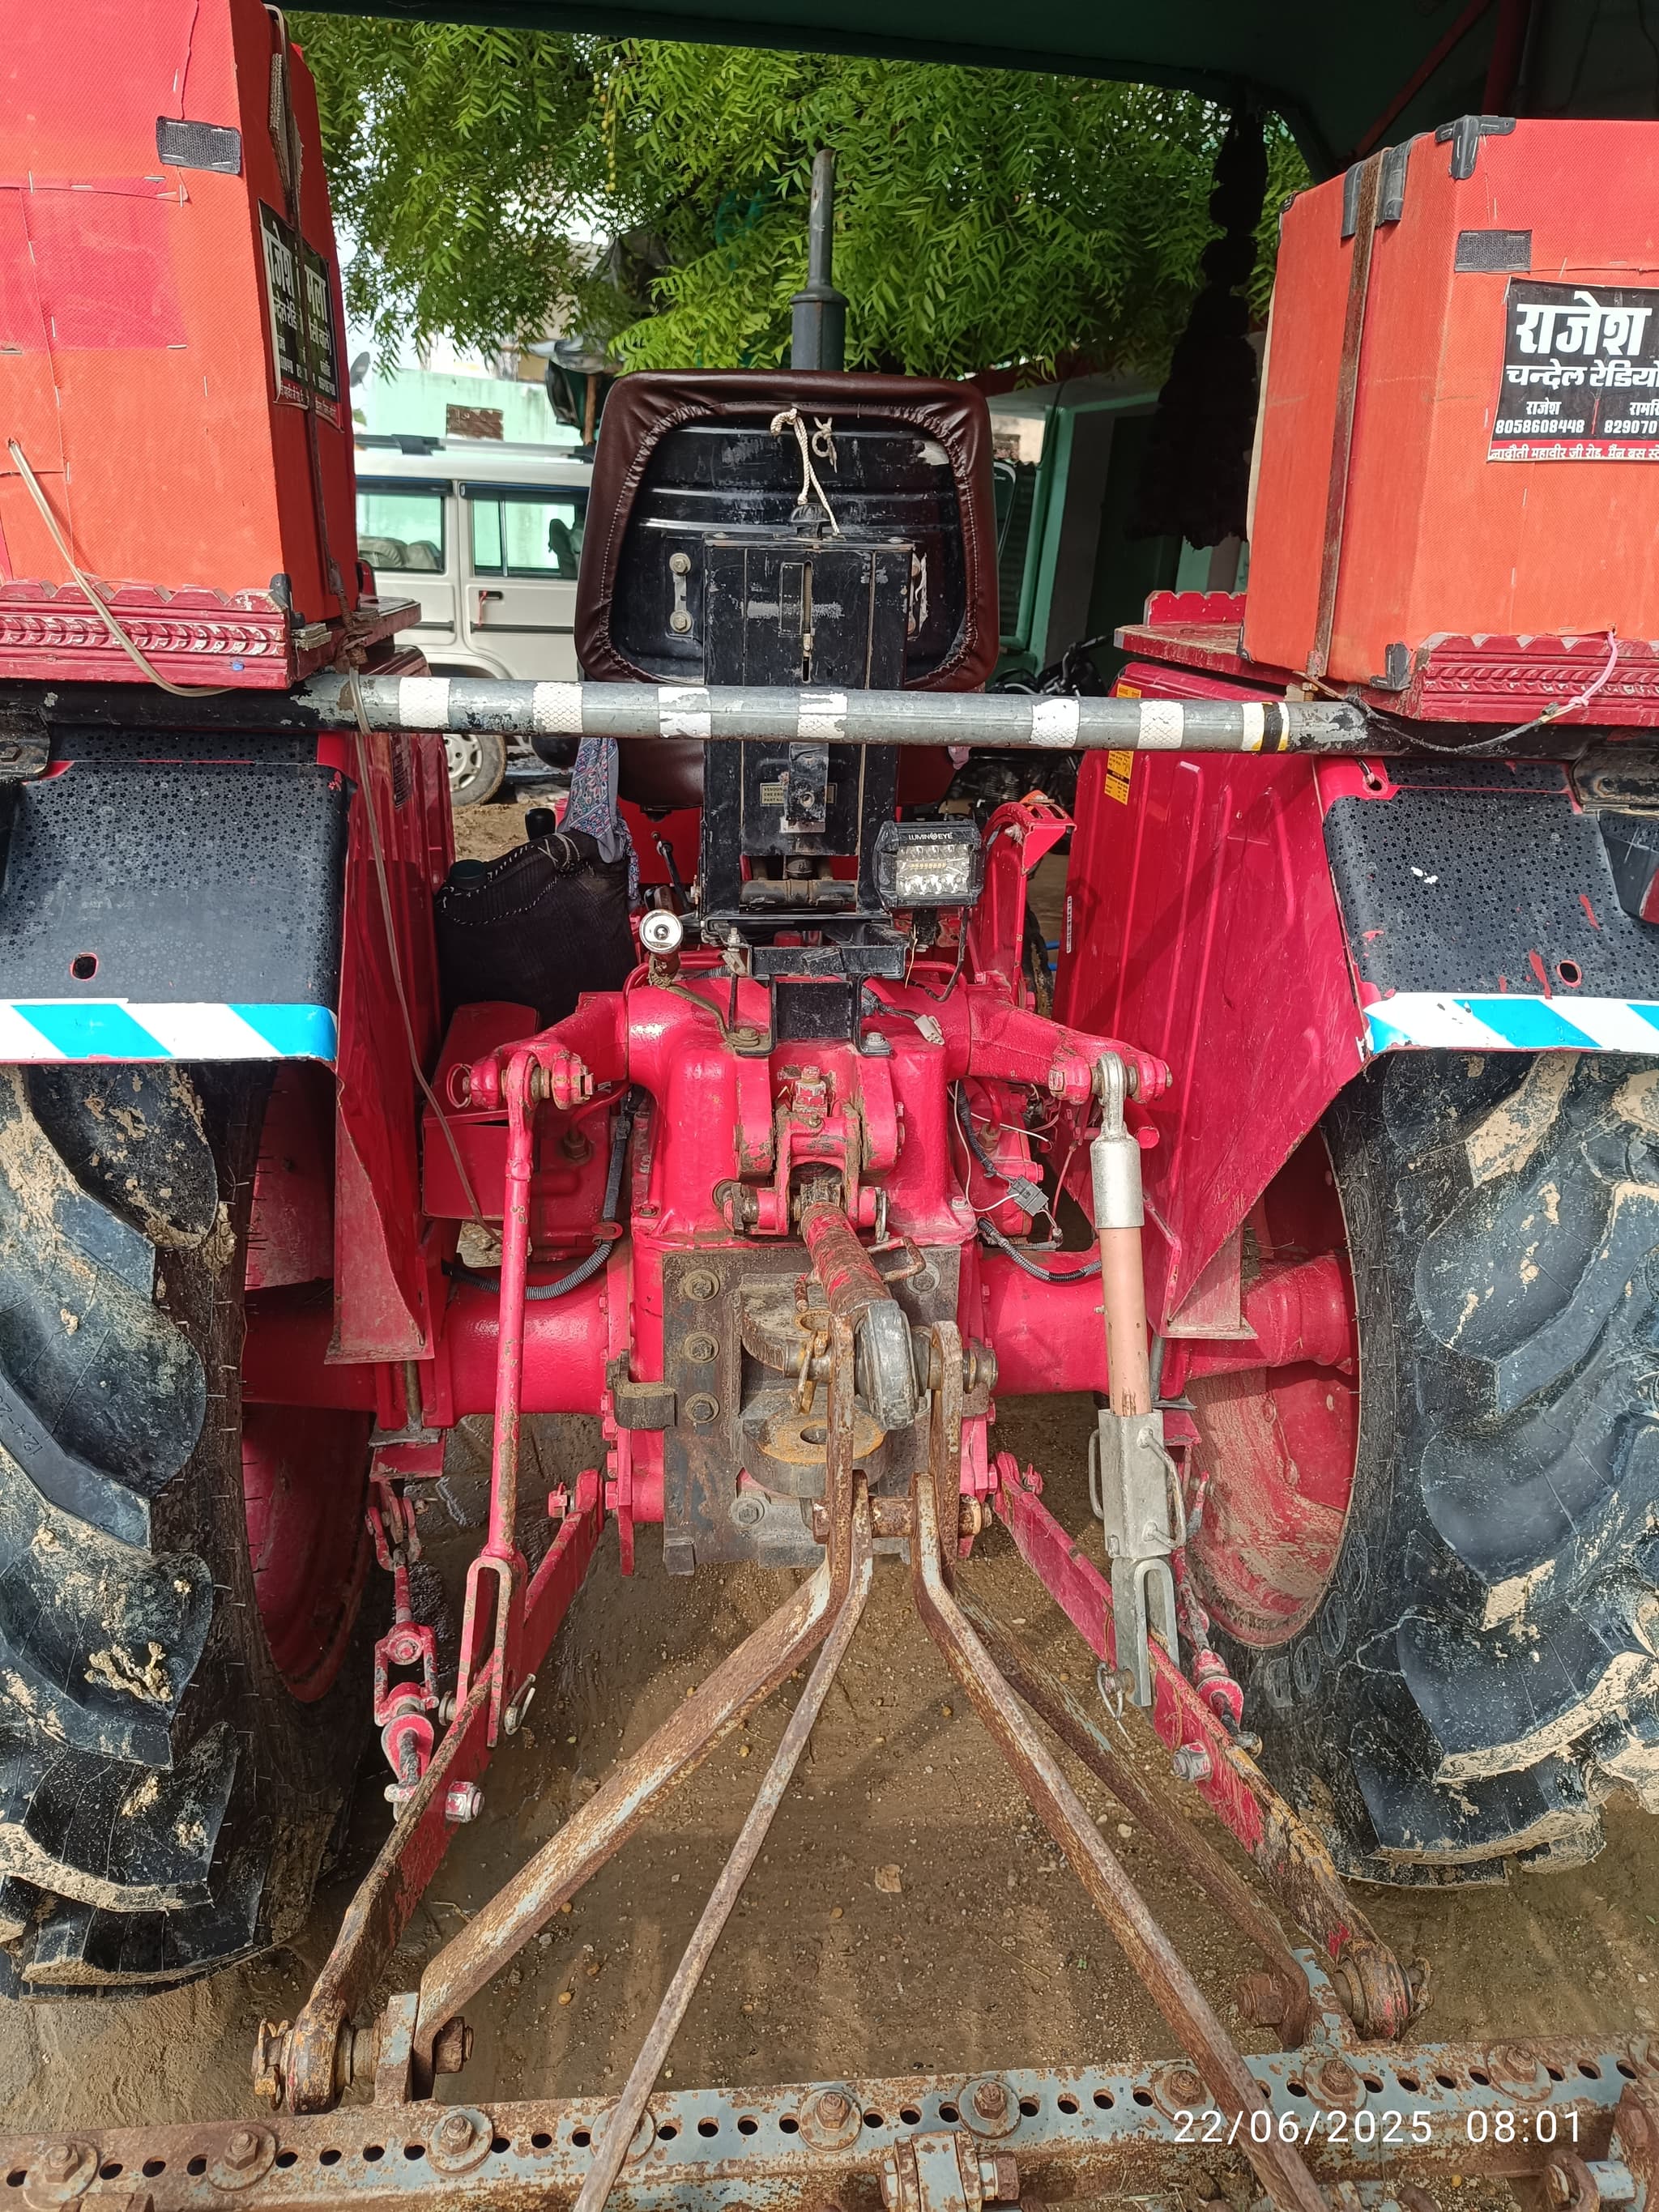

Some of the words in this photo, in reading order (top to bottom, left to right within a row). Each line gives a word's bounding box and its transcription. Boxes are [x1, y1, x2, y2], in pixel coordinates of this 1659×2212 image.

[1516, 291, 1653, 356] राजेश
[1506, 359, 1588, 390] चन्देल
[1526, 398, 1562, 416] राजेश
[1495, 419, 1585, 434] 8058608448
[1532, 443, 1567, 458] महावीर
[1569, 443, 1584, 458] जी
[1627, 447, 1646, 458] बस
